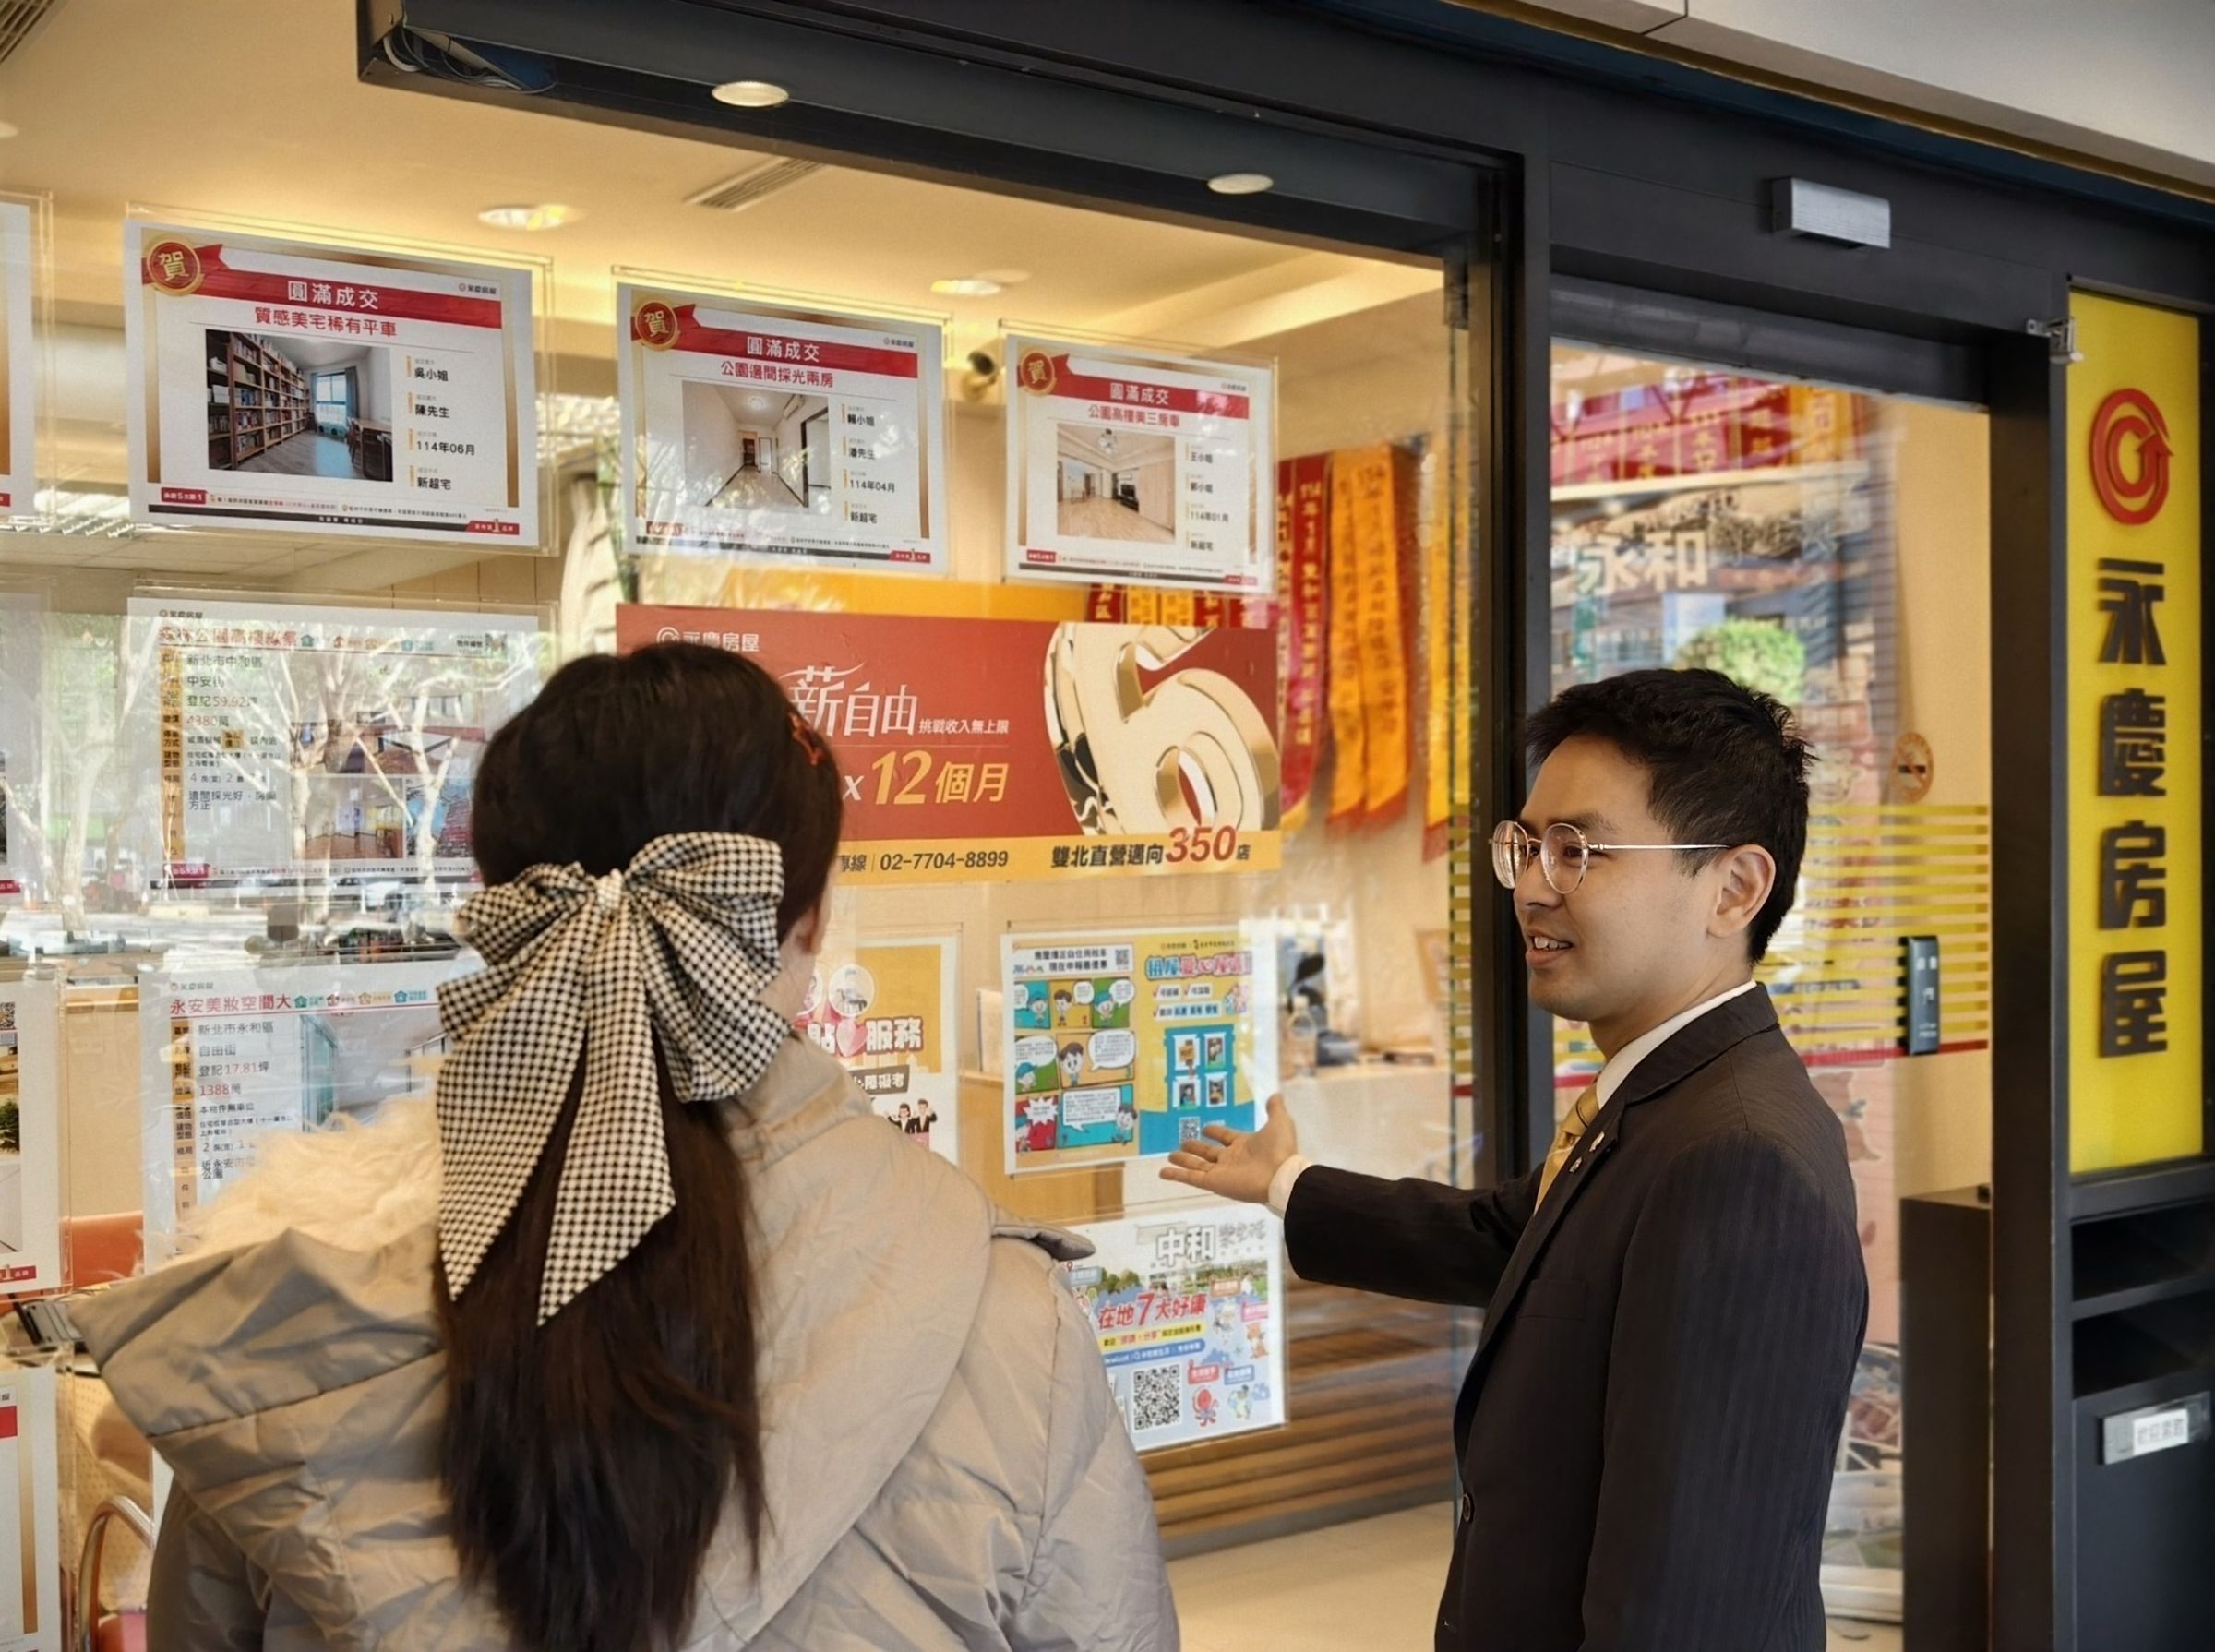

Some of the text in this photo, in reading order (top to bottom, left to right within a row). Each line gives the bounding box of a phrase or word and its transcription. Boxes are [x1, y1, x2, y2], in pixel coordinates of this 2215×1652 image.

[158, 250, 189, 281] 賀
[288, 280, 379, 310] 圓滿成交
[255, 307, 397, 337] 質感美宅稀有平車
[644, 309, 669, 338] 賀
[747, 337, 820, 363] 圓滿成交
[414, 367, 449, 382] 吳小姐
[721, 361, 834, 388] 公園邊間採光兩房
[1110, 382, 1169, 406] 圓滿成交
[415, 404, 450, 418] 陳先生
[416, 441, 475, 456] 114年06月
[417, 477, 451, 490] 新超宅
[850, 479, 895, 493] 114年04月
[778, 662, 918, 738] 薪自由
[918, 718, 1010, 735] 挑戰收入無上限
[188, 801, 211, 811] 方正
[2098, 557, 2167, 1058] 永慶房屋
[880, 850, 1009, 871] 02-7704-8899
[198, 1020, 274, 1035] 新北市永和區
[865, 1017, 922, 1053] 服務
[1156, 1225, 1216, 1268] 中和
